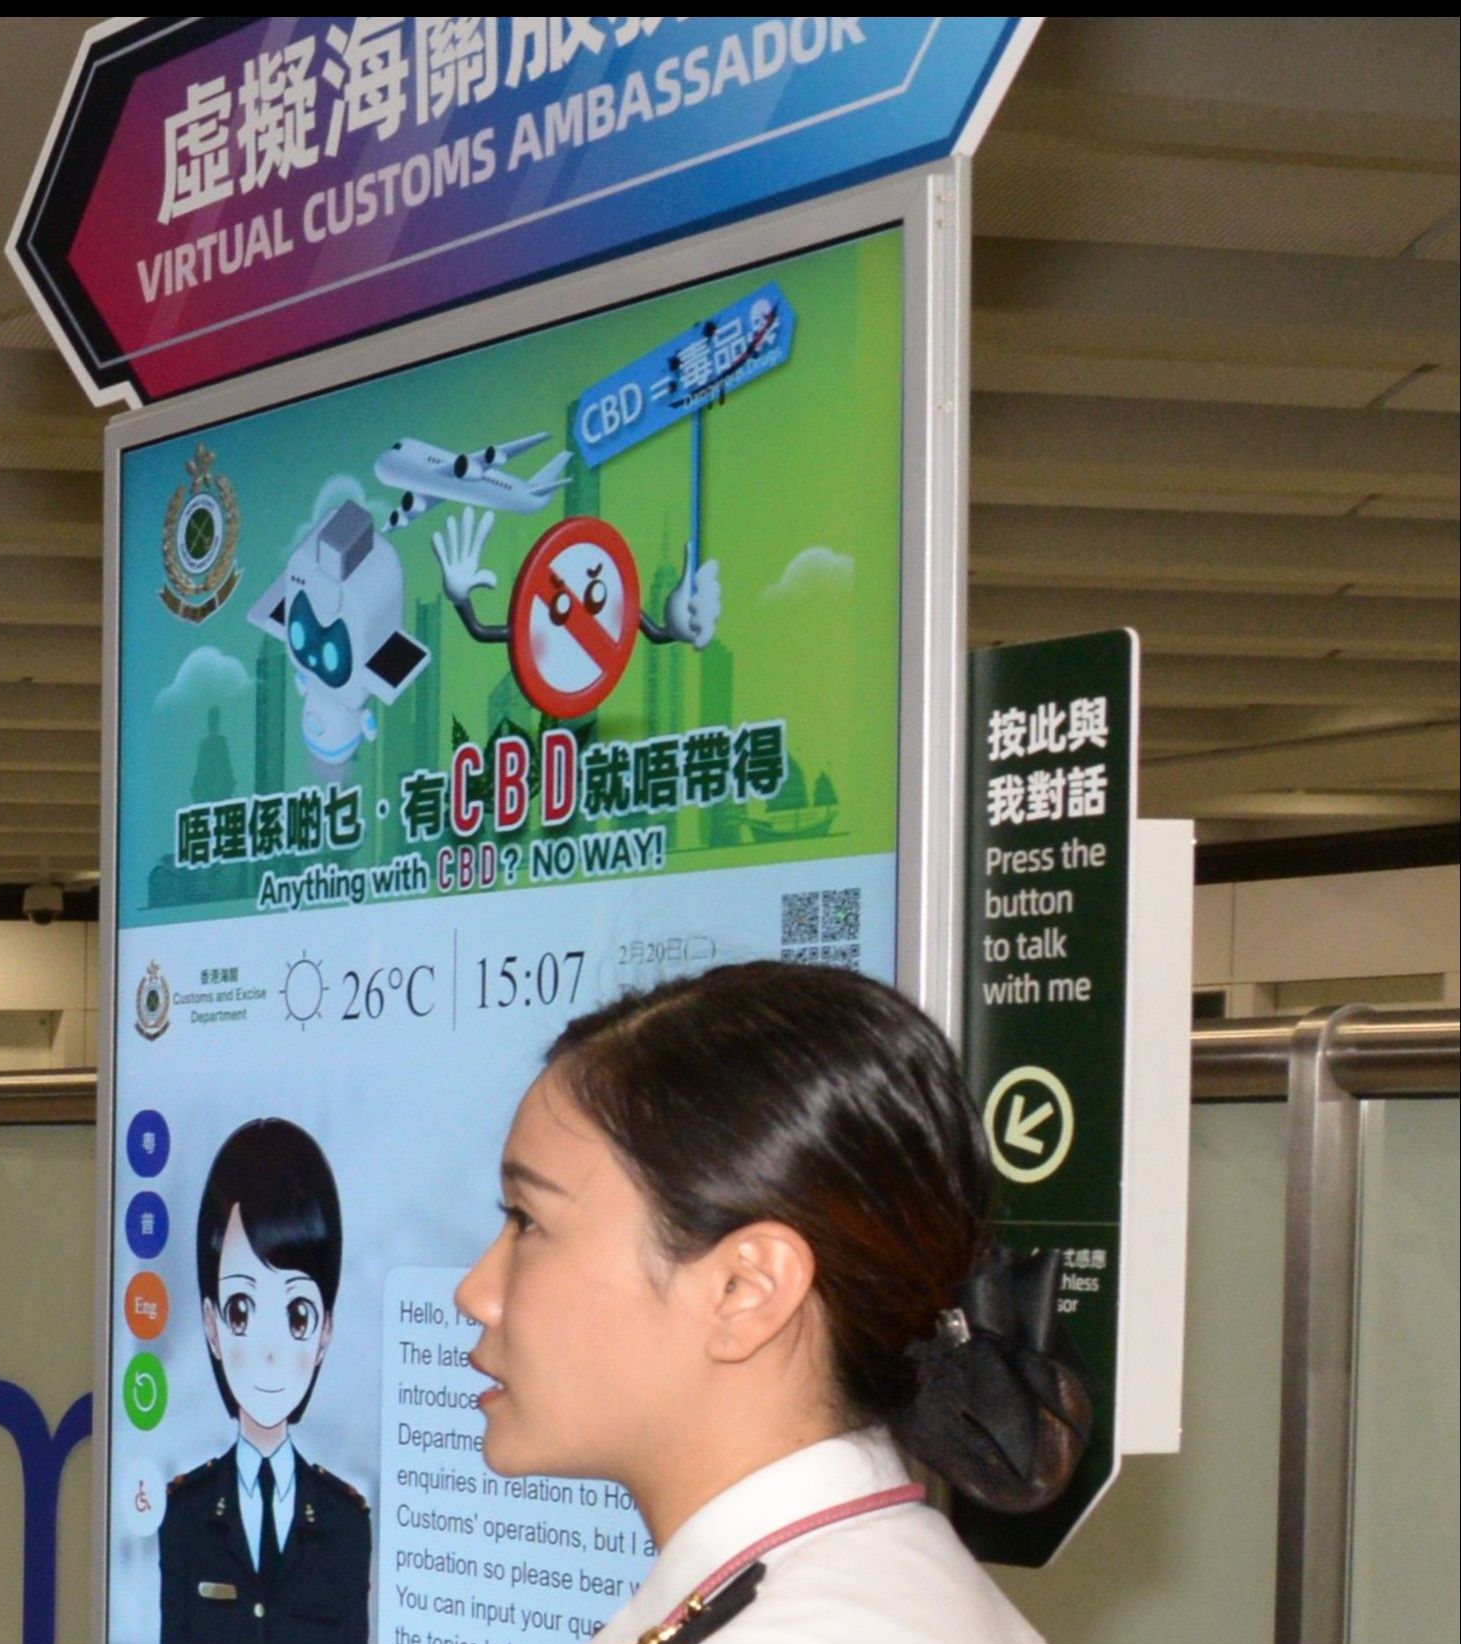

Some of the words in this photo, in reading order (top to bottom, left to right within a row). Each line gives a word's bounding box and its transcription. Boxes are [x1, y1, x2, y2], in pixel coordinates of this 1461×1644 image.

[157, 17, 686, 226] 虛擬海關服
[136, 207, 295, 304] VIRTUAL
[303, 127, 497, 243] CUSTOMS
[507, 17, 867, 172] AMBASSADOR
[581, 382, 643, 444] CBD
[677, 317, 747, 387] 毒品
[987, 696, 1109, 761] 按此與
[987, 764, 1109, 827] 我對話
[260, 870, 366, 911] Anything
[371, 865, 427, 896] with
[531, 848, 576, 878] NO
[578, 830, 665, 873] WAY!
[985, 847, 1054, 876] Press
[1060, 838, 1107, 870] the
[984, 888, 1073, 919] button
[618, 935, 716, 966] 2月20日(二)
[983, 934, 1010, 963] to
[1016, 927, 1068, 961] talk
[173, 989, 214, 1006] Customs
[216, 990, 235, 1001] and
[236, 986, 267, 1001] Excise
[340, 964, 436, 1021] 26°C
[476, 950, 586, 1010] 15:07
[983, 973, 1040, 1006] with
[1047, 977, 1092, 1002] me
[190, 1009, 247, 1025] Department
[1059, 1273, 1100, 1292] hless
[134, 1296, 158, 1321] Eng
[399, 1300, 449, 1329] Hello,
[399, 1341, 432, 1366] The
[397, 1468, 477, 1494] enquiries
[482, 1480, 498, 1497] in
[504, 1477, 573, 1503] relation
[579, 1483, 598, 1507] to
[396, 1503, 478, 1535] Customs'
[482, 1518, 587, 1553] operations,
[593, 1527, 625, 1554] but
[632, 1536, 637, 1555] I
[396, 1548, 477, 1577] probation
[483, 1563, 505, 1580] so
[511, 1564, 573, 1590] please
[579, 1569, 623, 1597] bear
[395, 1584, 428, 1610] You
[433, 1594, 466, 1615] can
[470, 1596, 517, 1627] input
[520, 1607, 562, 1632] your
